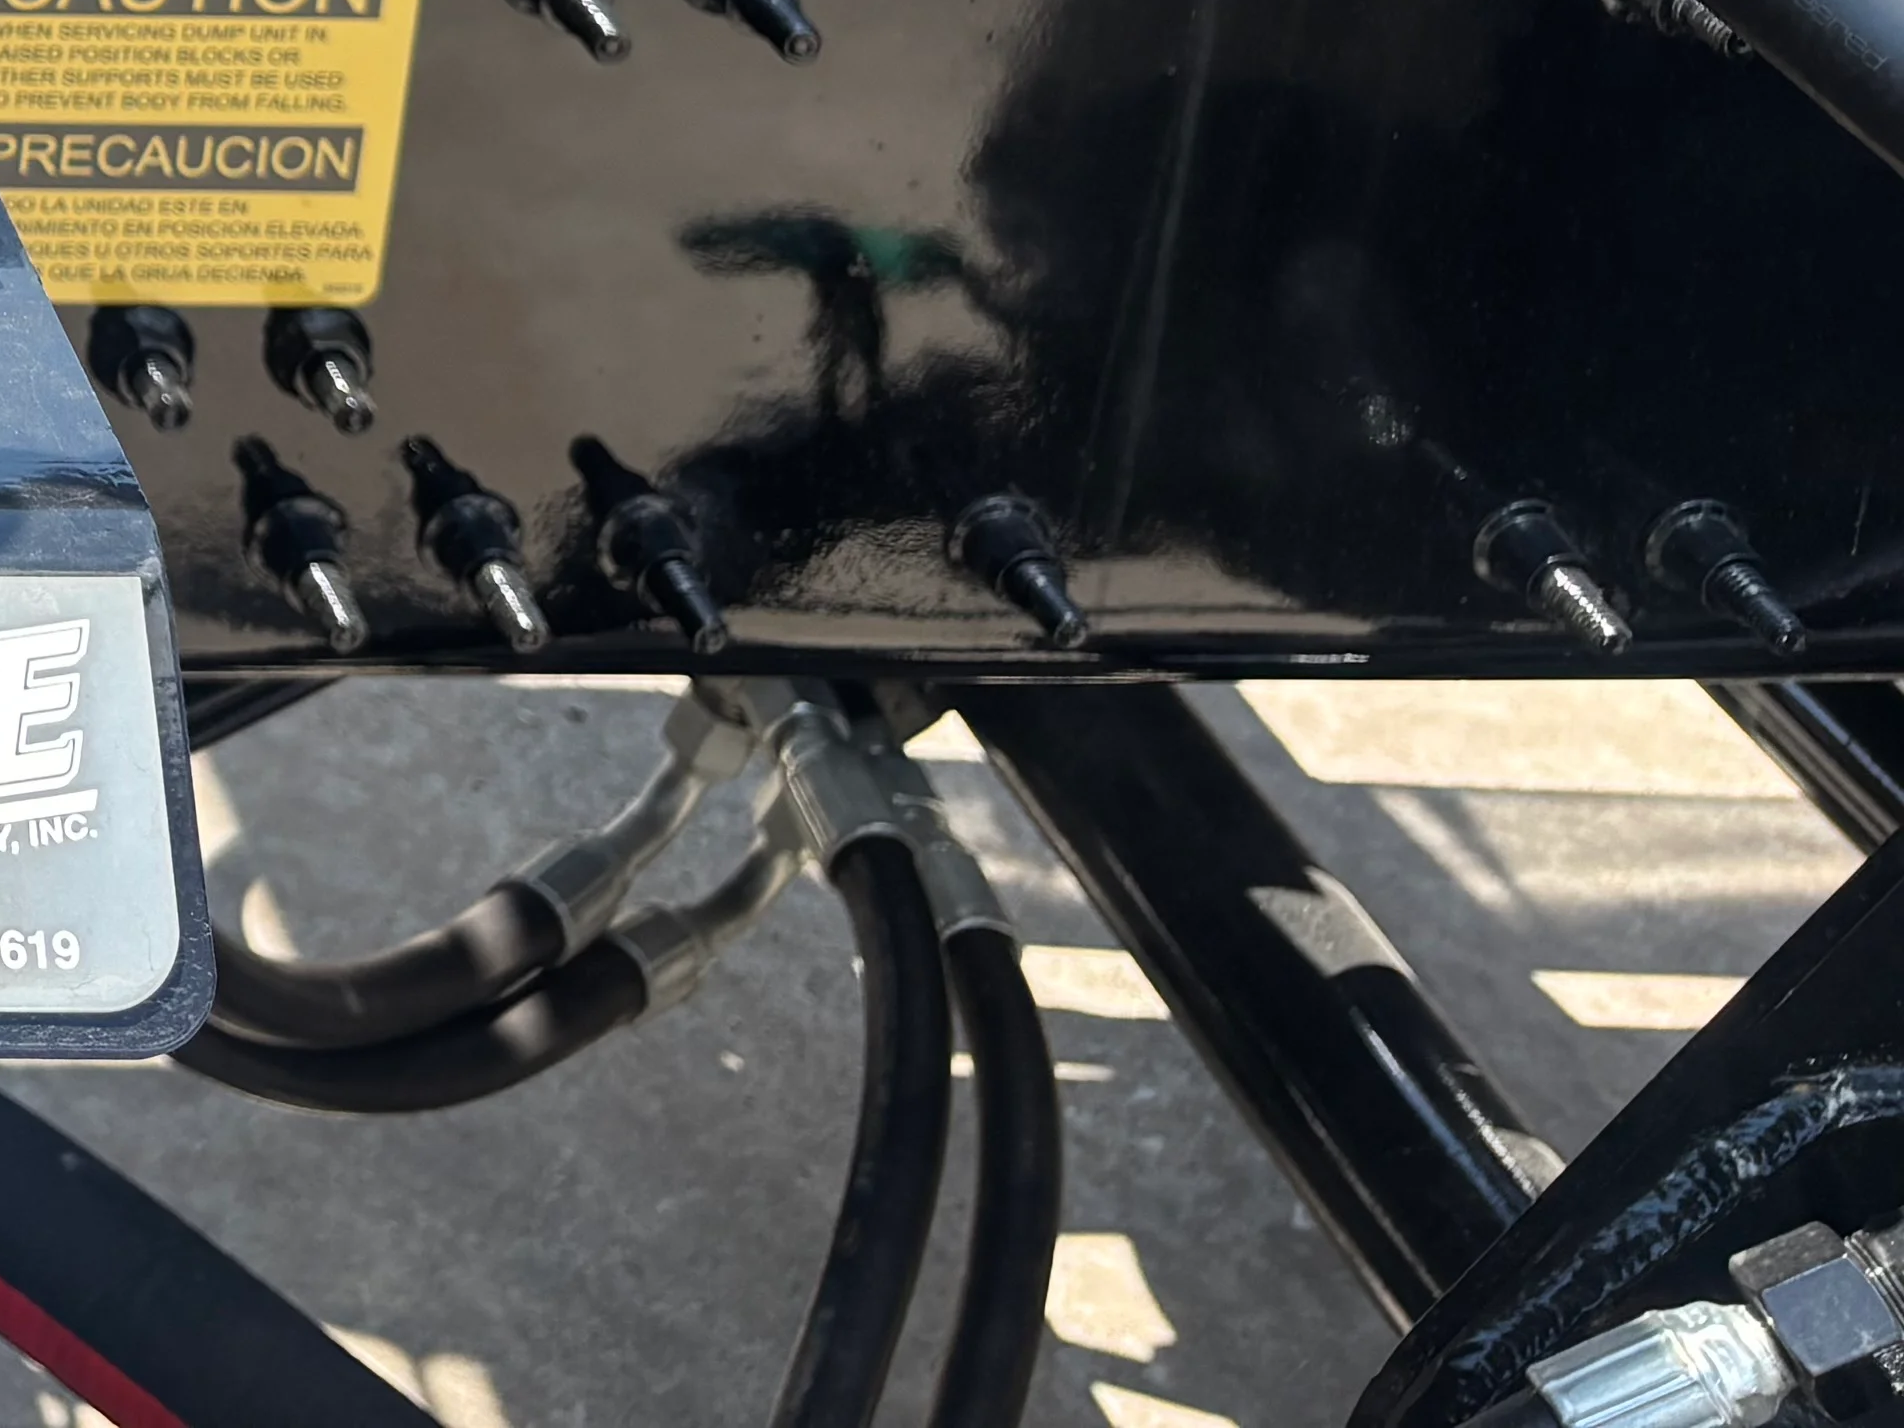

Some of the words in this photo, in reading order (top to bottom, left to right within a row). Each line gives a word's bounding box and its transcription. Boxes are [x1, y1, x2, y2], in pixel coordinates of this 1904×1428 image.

[58, 21, 177, 41] SERVICING
[181, 23, 245, 42] DUMP
[249, 24, 300, 42] UNIT
[305, 25, 328, 42] IN
[68, 44, 170, 64] POSITION
[175, 46, 263, 65] BLOCKS
[267, 47, 300, 66] OR
[61, 67, 179, 87] SUPPORTS
[185, 70, 244, 88] MUST
[250, 70, 279, 89] BE
[284, 71, 345, 90] USED
[14, 90, 115, 109] PREVENT
[121, 92, 180, 110] BODY
[186, 93, 250, 111] FROM
[41, 197, 67, 214] LA
[72, 197, 153, 215] UNIDAD
[158, 197, 212, 215] ESTE
[218, 198, 247, 216] EN
[122, 220, 153, 237] EN
[158, 220, 261, 238] POSICION
[94, 243, 110, 259] U
[114, 242, 190, 260] OTROS
[196, 243, 312, 261] SOPORTES
[315, 243, 373, 262] PARA
[48, 263, 96, 283] QUE
[99, 263, 125, 282] LA
[130, 264, 190, 283] GRUA
[28, 813, 99, 847] INC.
